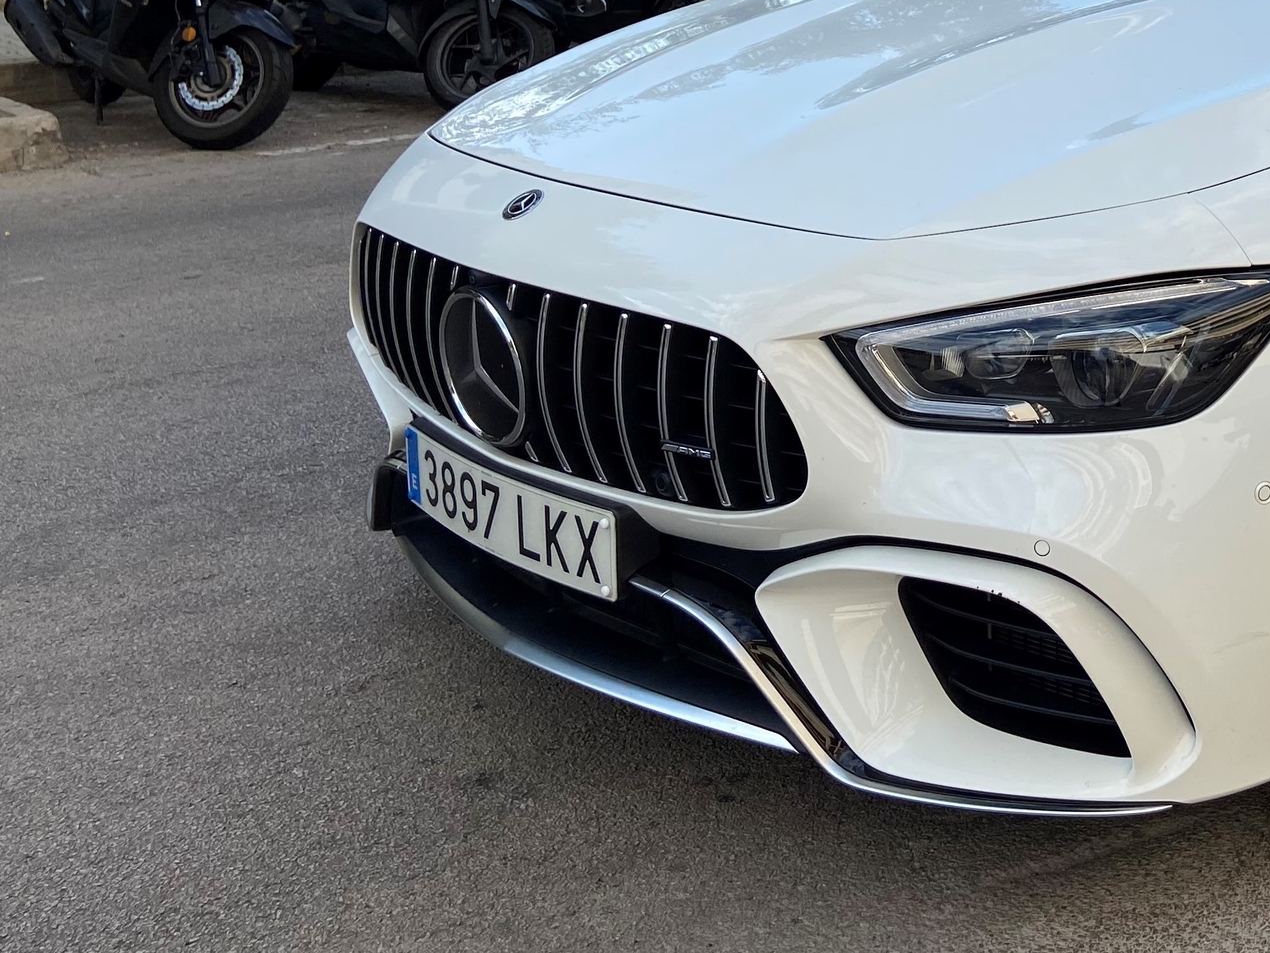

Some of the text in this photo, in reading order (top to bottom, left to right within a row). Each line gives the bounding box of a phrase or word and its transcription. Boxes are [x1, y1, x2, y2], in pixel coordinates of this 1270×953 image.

[676, 446, 712, 459] AMG
[411, 472, 418, 490] E
[424, 449, 601, 584] 3897 LKX
